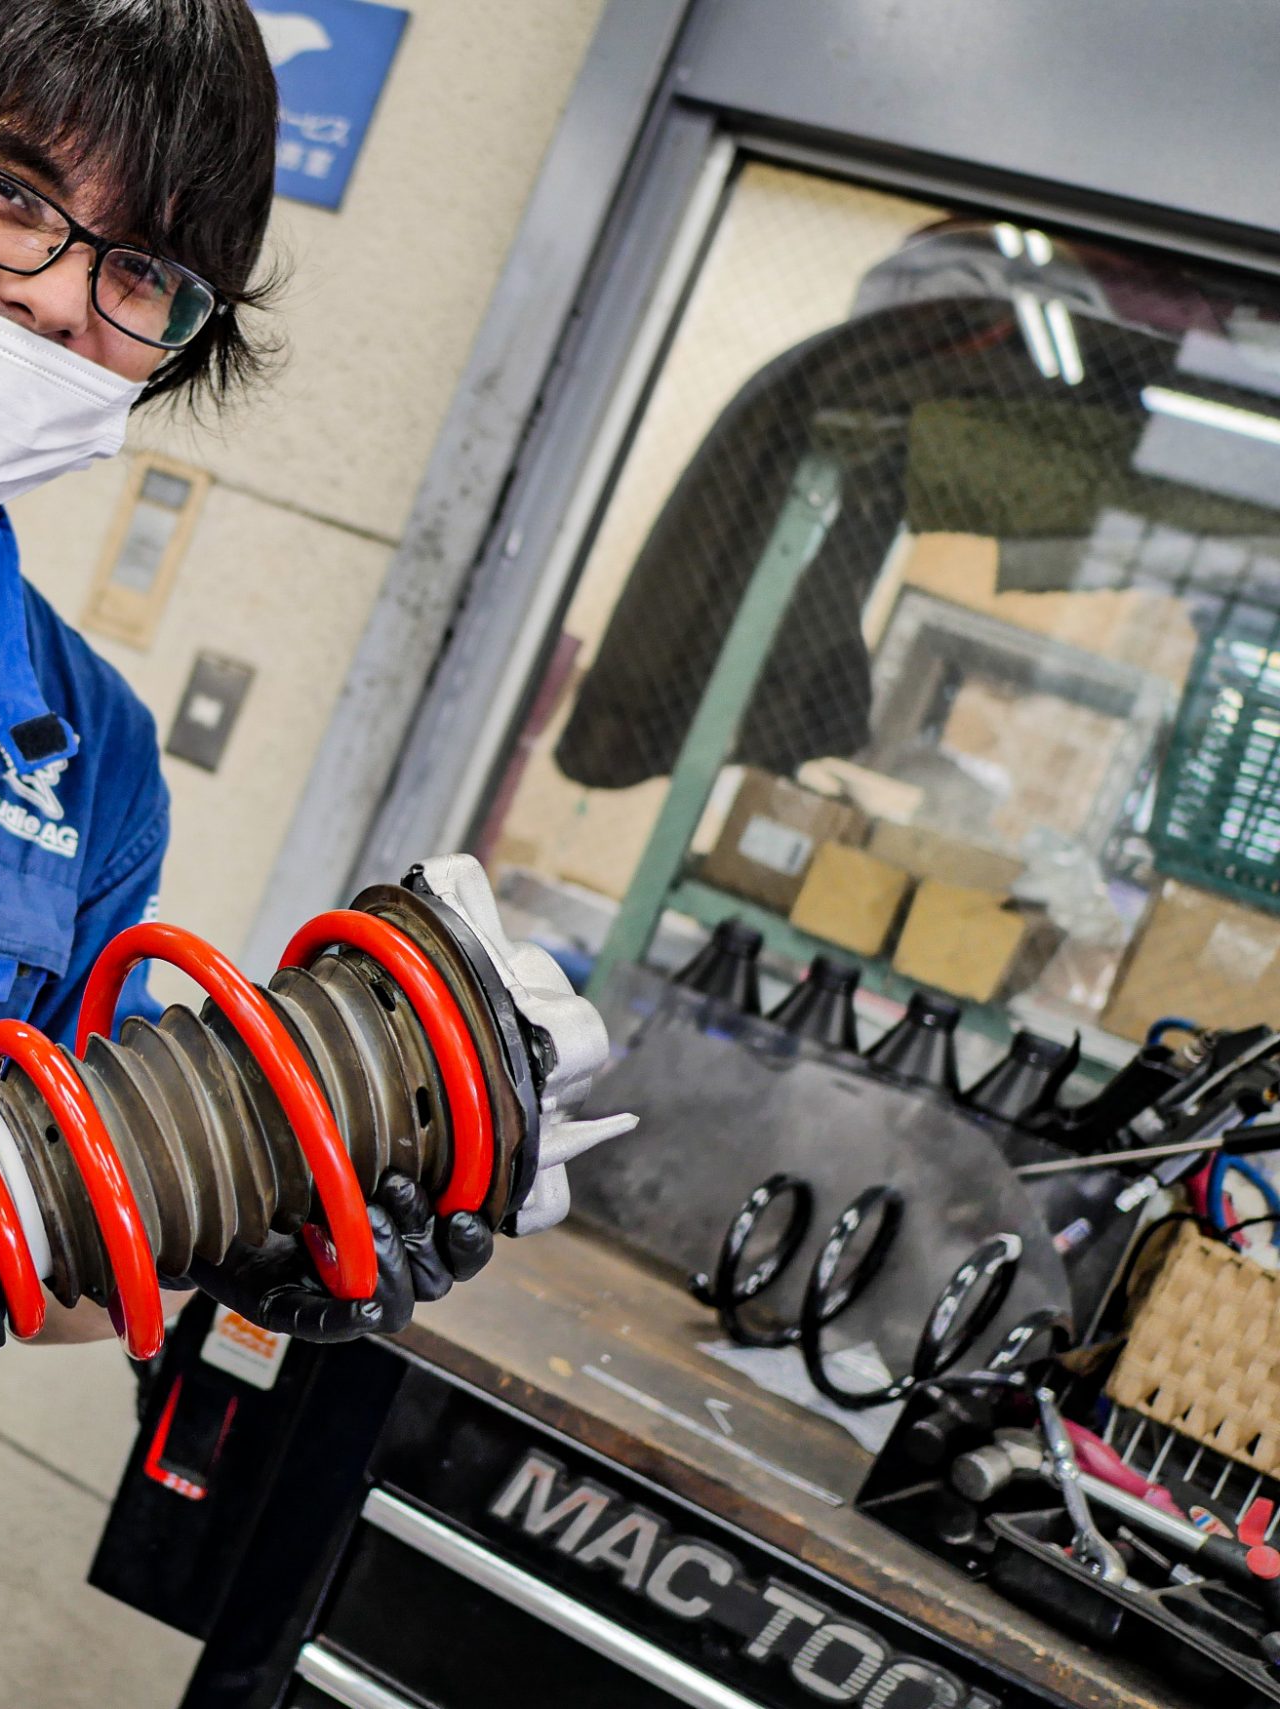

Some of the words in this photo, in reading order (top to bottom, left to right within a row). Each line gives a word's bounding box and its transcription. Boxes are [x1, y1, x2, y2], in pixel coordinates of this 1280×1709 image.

[40, 822, 79, 848] AG
[488, 1455, 734, 1620] MAC
[746, 1585, 993, 1709] TOO
